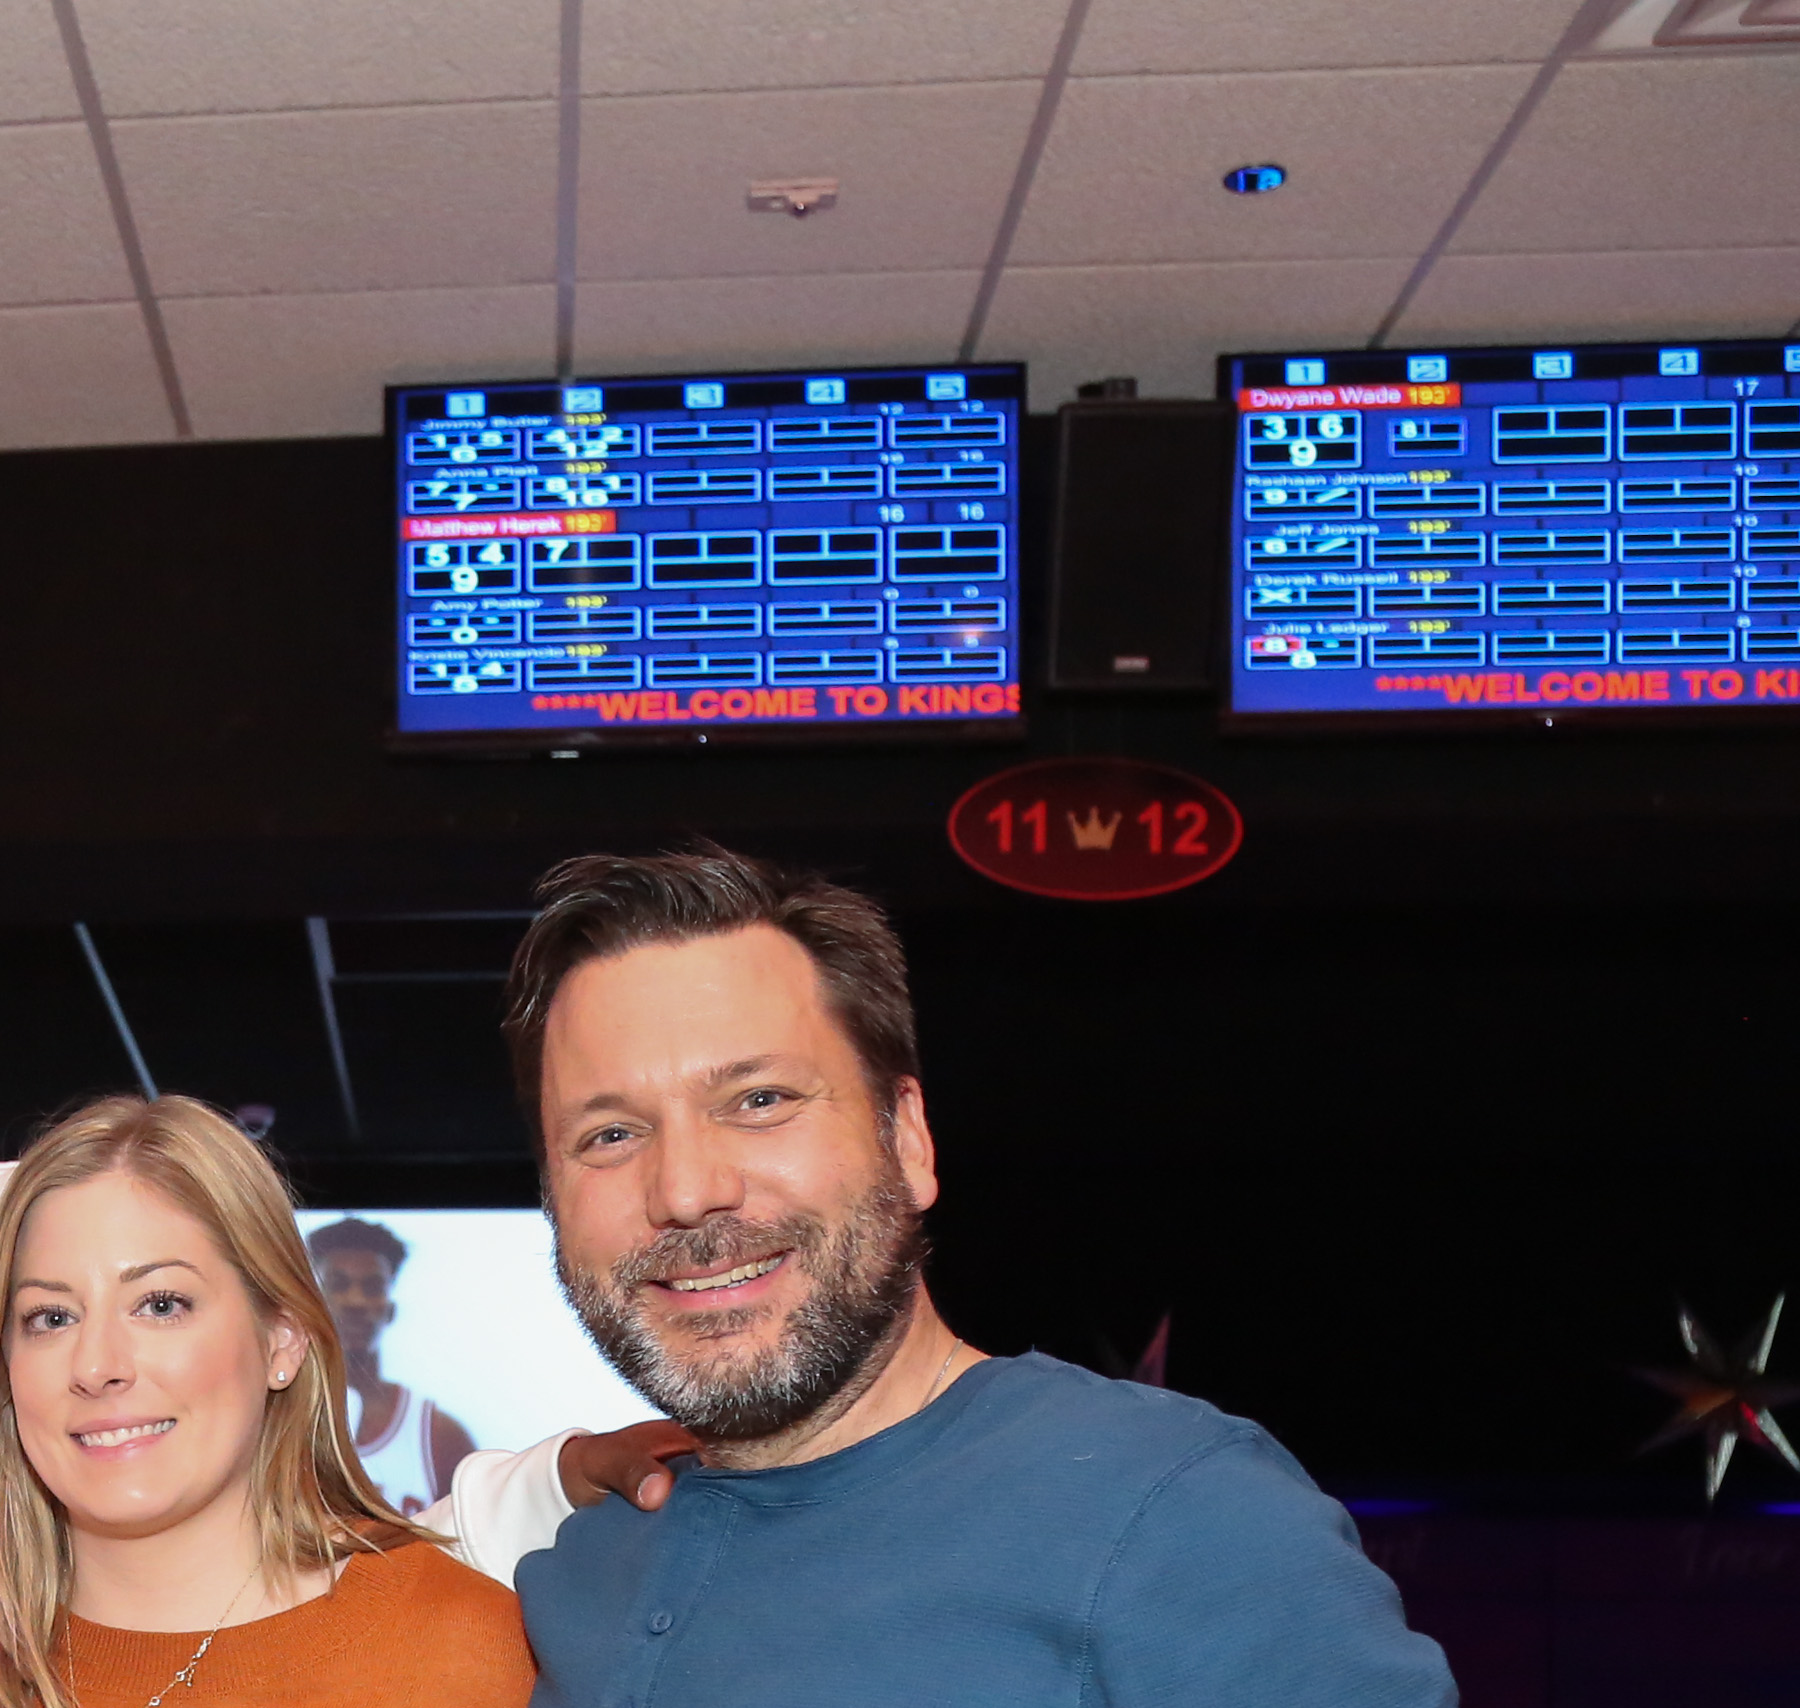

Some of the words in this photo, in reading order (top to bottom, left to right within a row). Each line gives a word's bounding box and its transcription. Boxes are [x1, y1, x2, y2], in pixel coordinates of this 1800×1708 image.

[1251, 388, 1336, 410] Dwyane
[1339, 386, 1402, 404] Wade
[1733, 377, 1759, 397] 17
[1262, 415, 1287, 441] 3
[1318, 413, 1344, 439] 6
[1288, 439, 1318, 467] 9
[410, 520, 497, 537] Matthew
[499, 517, 562, 534] Herek
[478, 542, 505, 565] 4
[544, 539, 569, 563] 7
[450, 566, 479, 593] 9
[1321, 571, 1399, 585] Russell
[1680, 669, 1744, 700] TO
[827, 686, 888, 716] TO
[986, 800, 1047, 854] 11
[1137, 801, 1209, 855] 12
